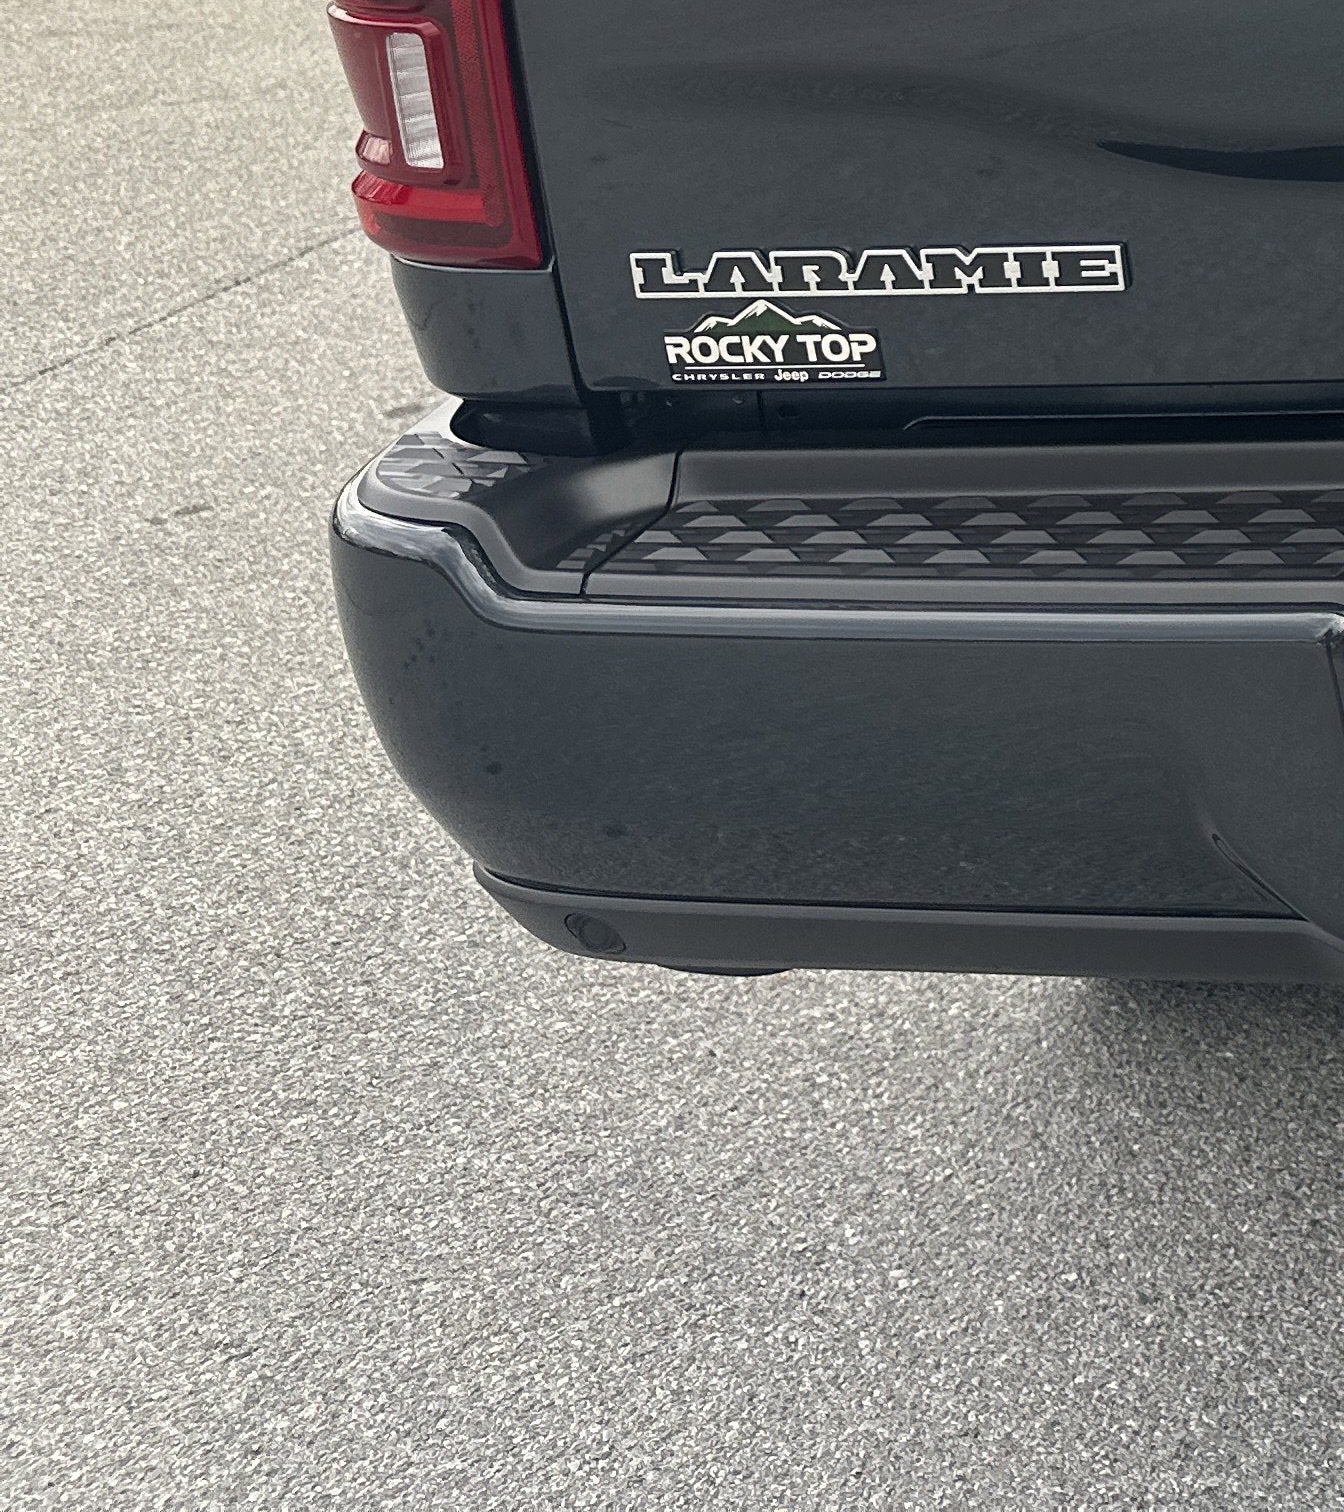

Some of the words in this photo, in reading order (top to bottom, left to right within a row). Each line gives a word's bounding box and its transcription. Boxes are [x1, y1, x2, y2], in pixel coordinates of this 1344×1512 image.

[629, 244, 1130, 299] LARAMIE
[664, 334, 790, 364] ROCKY
[796, 333, 877, 363] TOP
[671, 372, 765, 381] CHRYSLER
[774, 369, 809, 382] Jeep
[817, 370, 882, 379] DODGE
